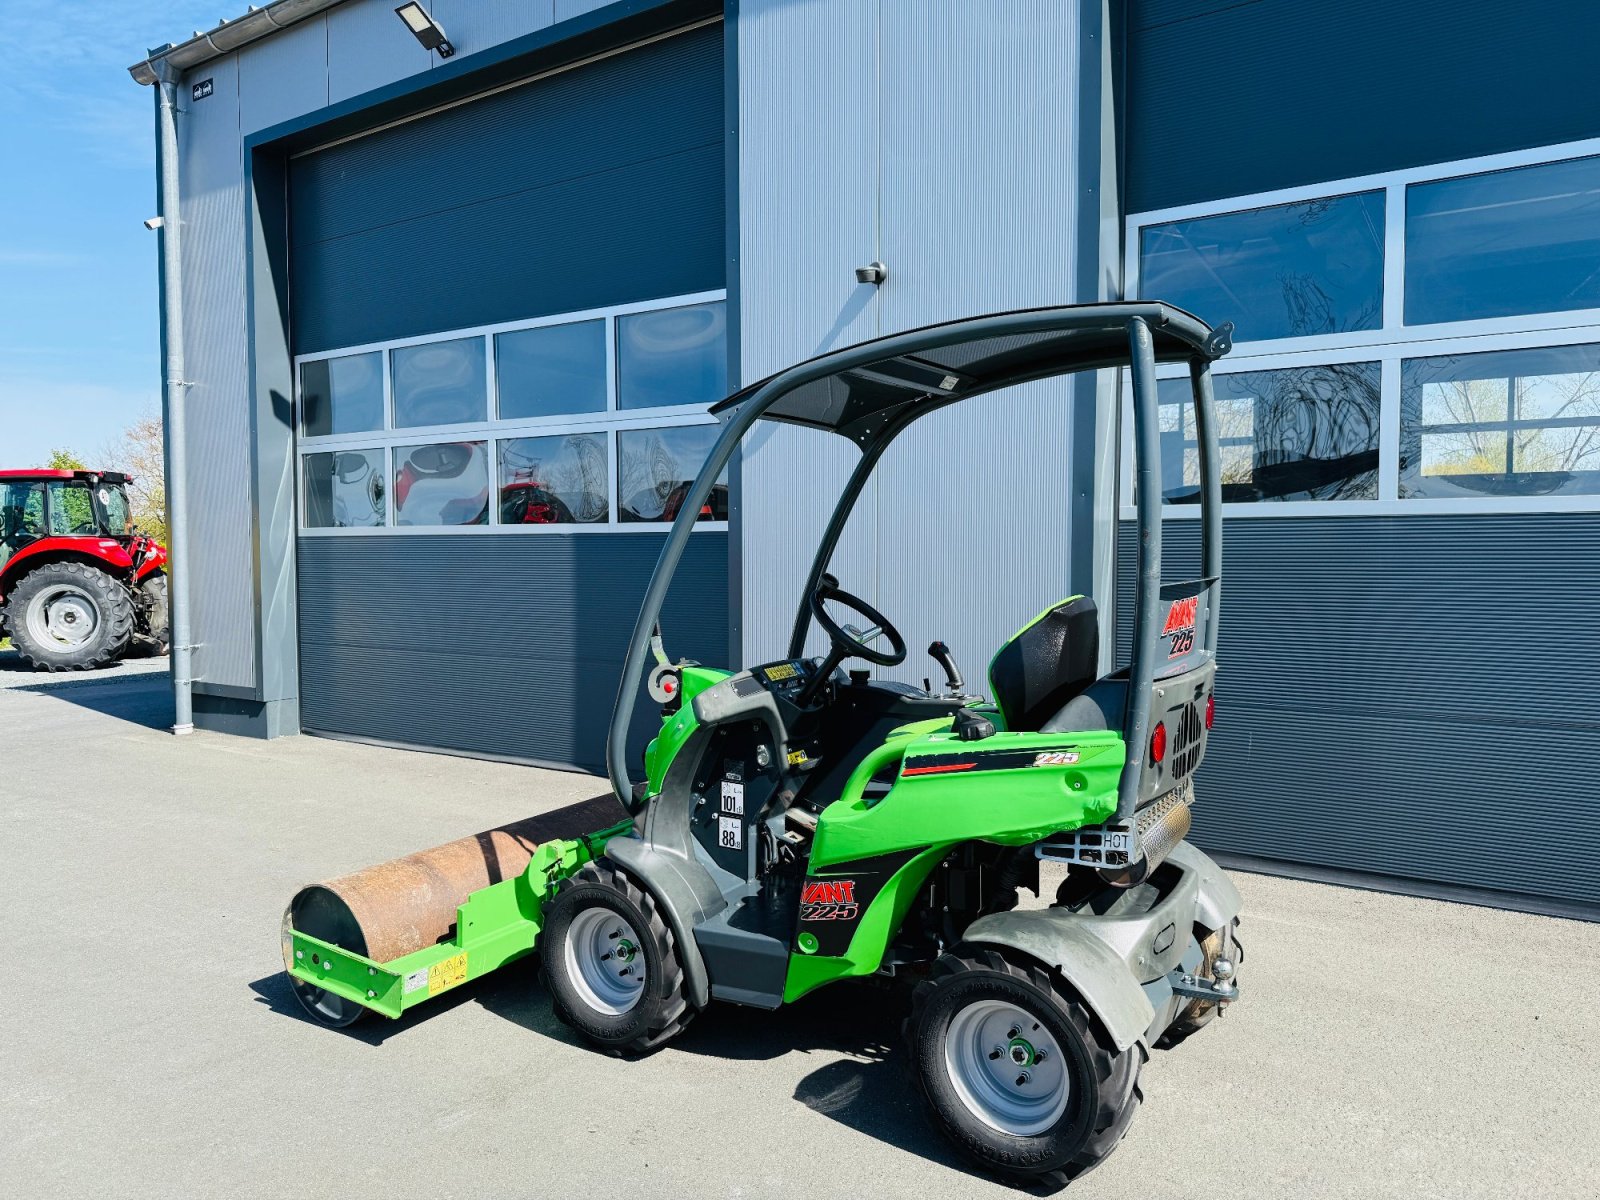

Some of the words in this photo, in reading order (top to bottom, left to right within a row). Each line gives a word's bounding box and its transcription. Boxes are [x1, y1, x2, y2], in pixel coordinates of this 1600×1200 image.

[1168, 629, 1195, 660] 225
[1033, 752, 1080, 767] 225
[723, 795, 736, 812] 101
[722, 830, 735, 847] 88
[1104, 834, 1129, 849] HOT
[801, 880, 855, 905] VANT
[801, 903, 859, 921] 225
